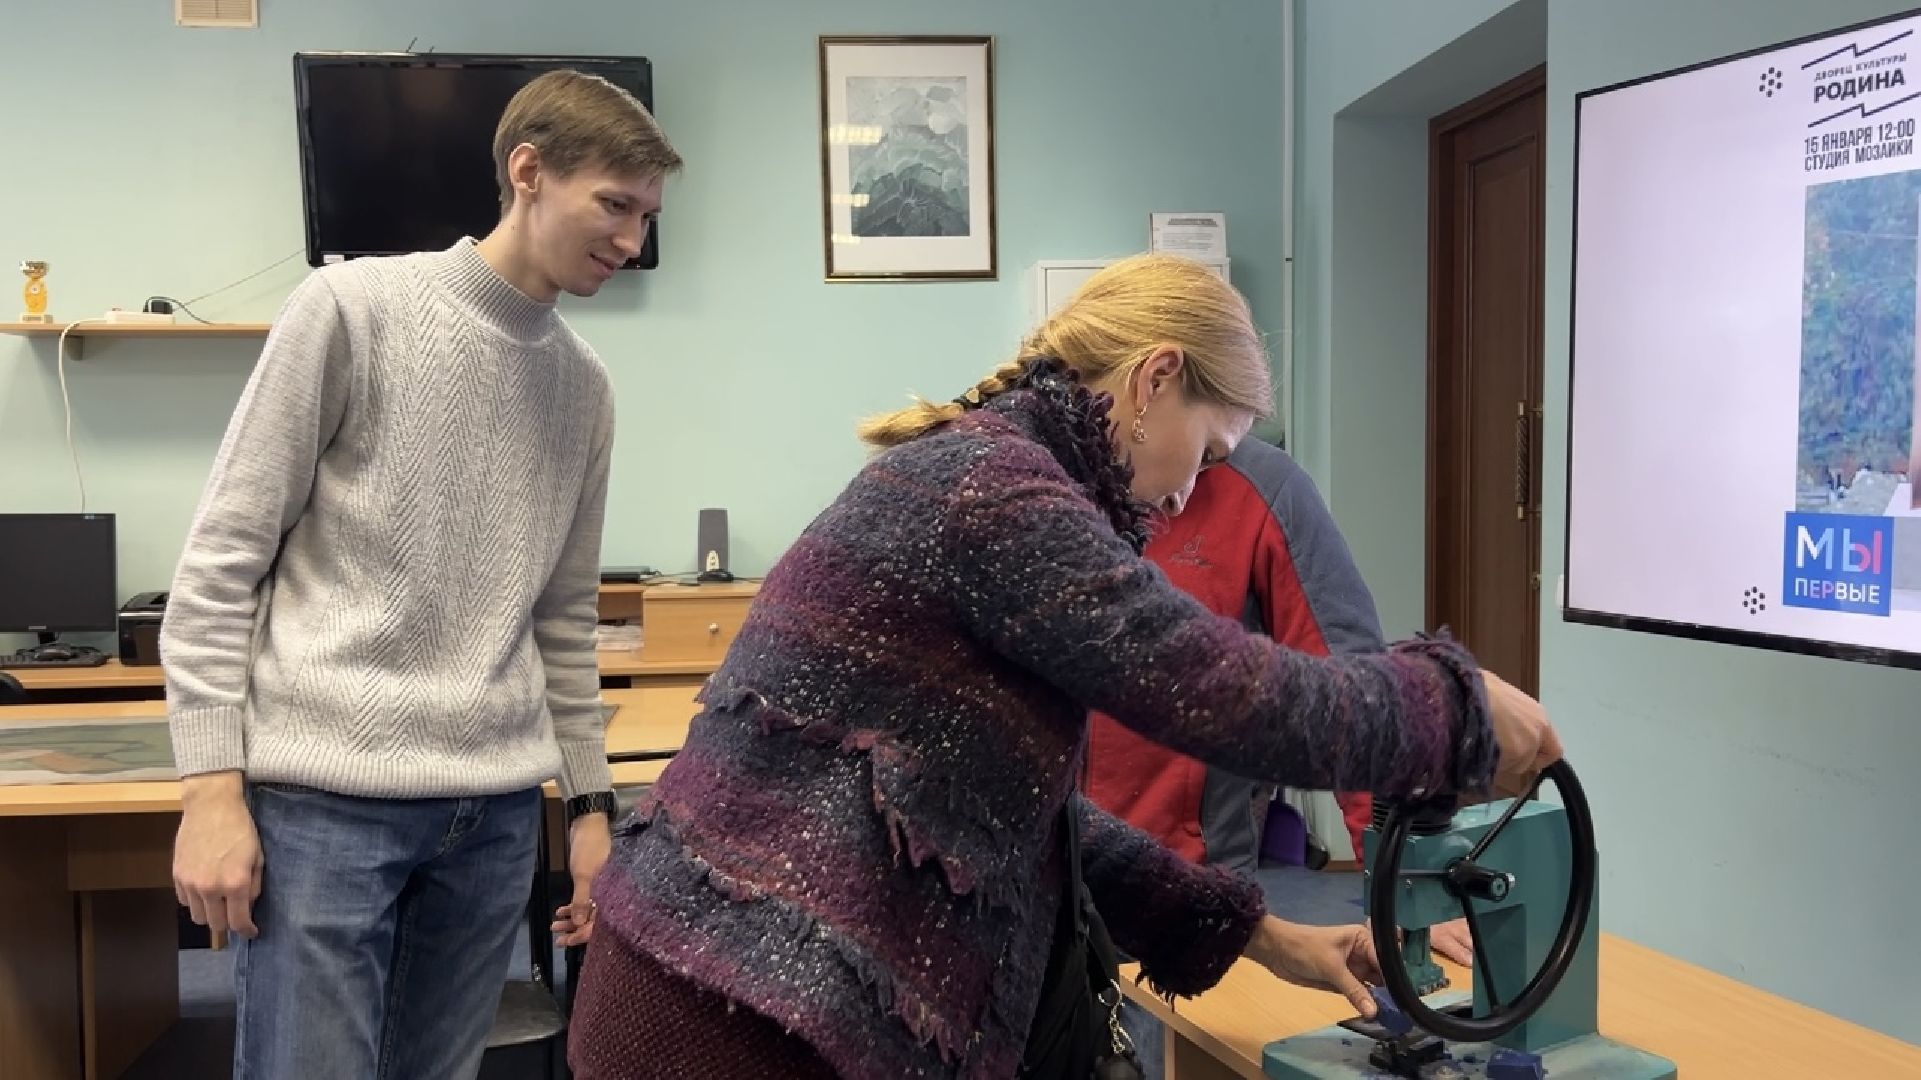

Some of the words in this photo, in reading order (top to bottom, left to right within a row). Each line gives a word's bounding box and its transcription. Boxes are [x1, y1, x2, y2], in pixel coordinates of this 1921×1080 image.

[1814, 65, 1853, 82] ДВОРЕЦ
[1855, 53, 1907, 71] КУЛЬТУРЫ
[1814, 67, 1905, 104] РОДИНА
[1804, 136, 1819, 155] 15
[1822, 126, 1873, 152] ЯНВАРЯ
[1879, 118, 1915, 143] 12:00
[1804, 150, 1850, 172] СТУДИЯ
[1855, 139, 1913, 164] МОЗАИКИ
[1796, 525, 1883, 575] МЫ
[1795, 577, 1880, 604] ПЕРВЫЕ
